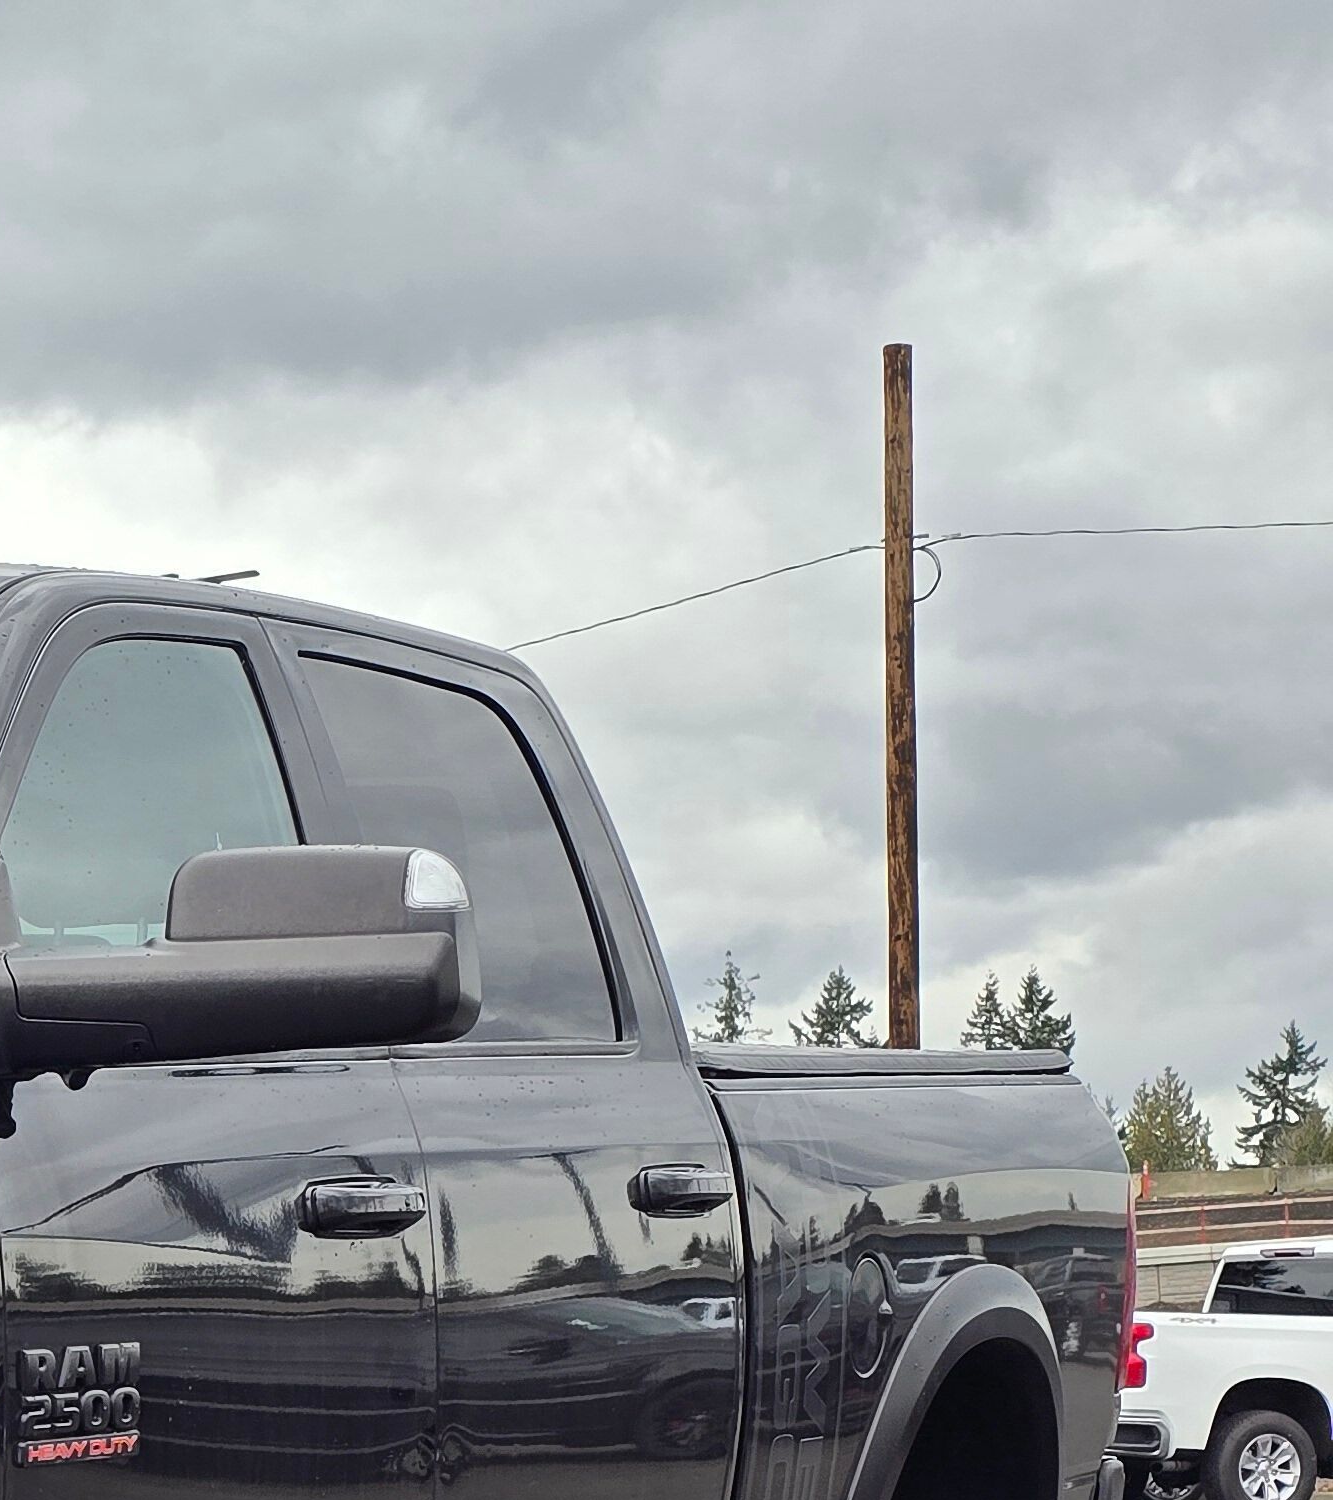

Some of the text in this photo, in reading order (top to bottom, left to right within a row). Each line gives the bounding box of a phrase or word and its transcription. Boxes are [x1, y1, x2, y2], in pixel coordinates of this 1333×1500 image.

[20, 1342, 141, 1389] RAM
[18, 1386, 141, 1438] 2500
[27, 1434, 139, 1463] HEAVY DUTY
